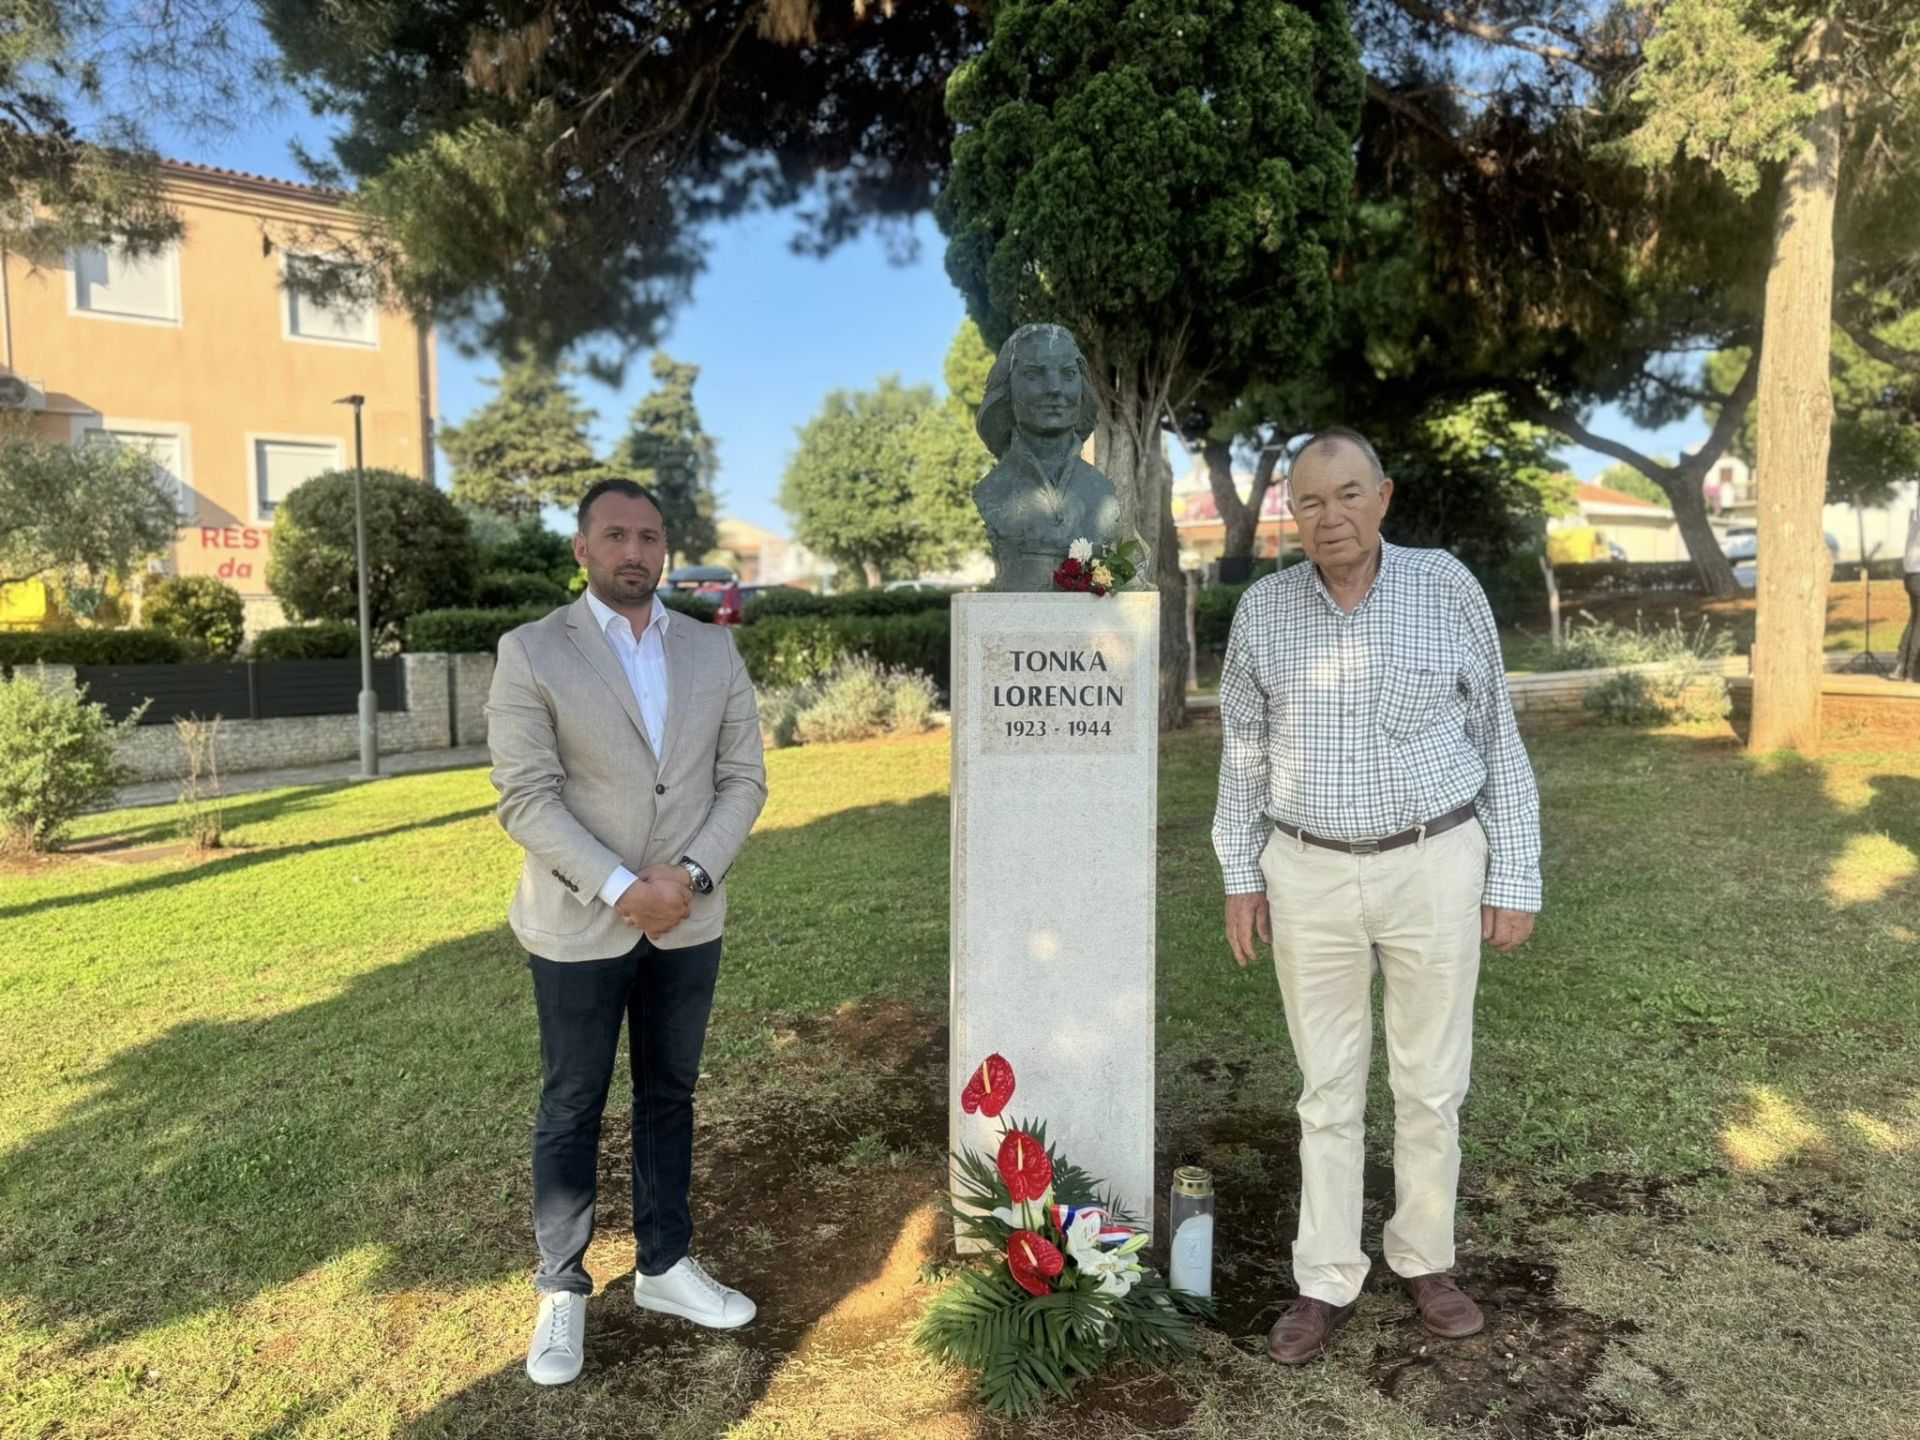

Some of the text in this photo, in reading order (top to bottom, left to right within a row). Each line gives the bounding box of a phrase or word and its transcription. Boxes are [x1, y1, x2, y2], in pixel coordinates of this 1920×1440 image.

[218, 557, 252, 578] da
[1010, 651, 1107, 672] TONKA
[994, 685, 1123, 707] LORENCIN
[1005, 720, 1047, 737] 1923
[1068, 720, 1112, 737] 1944
